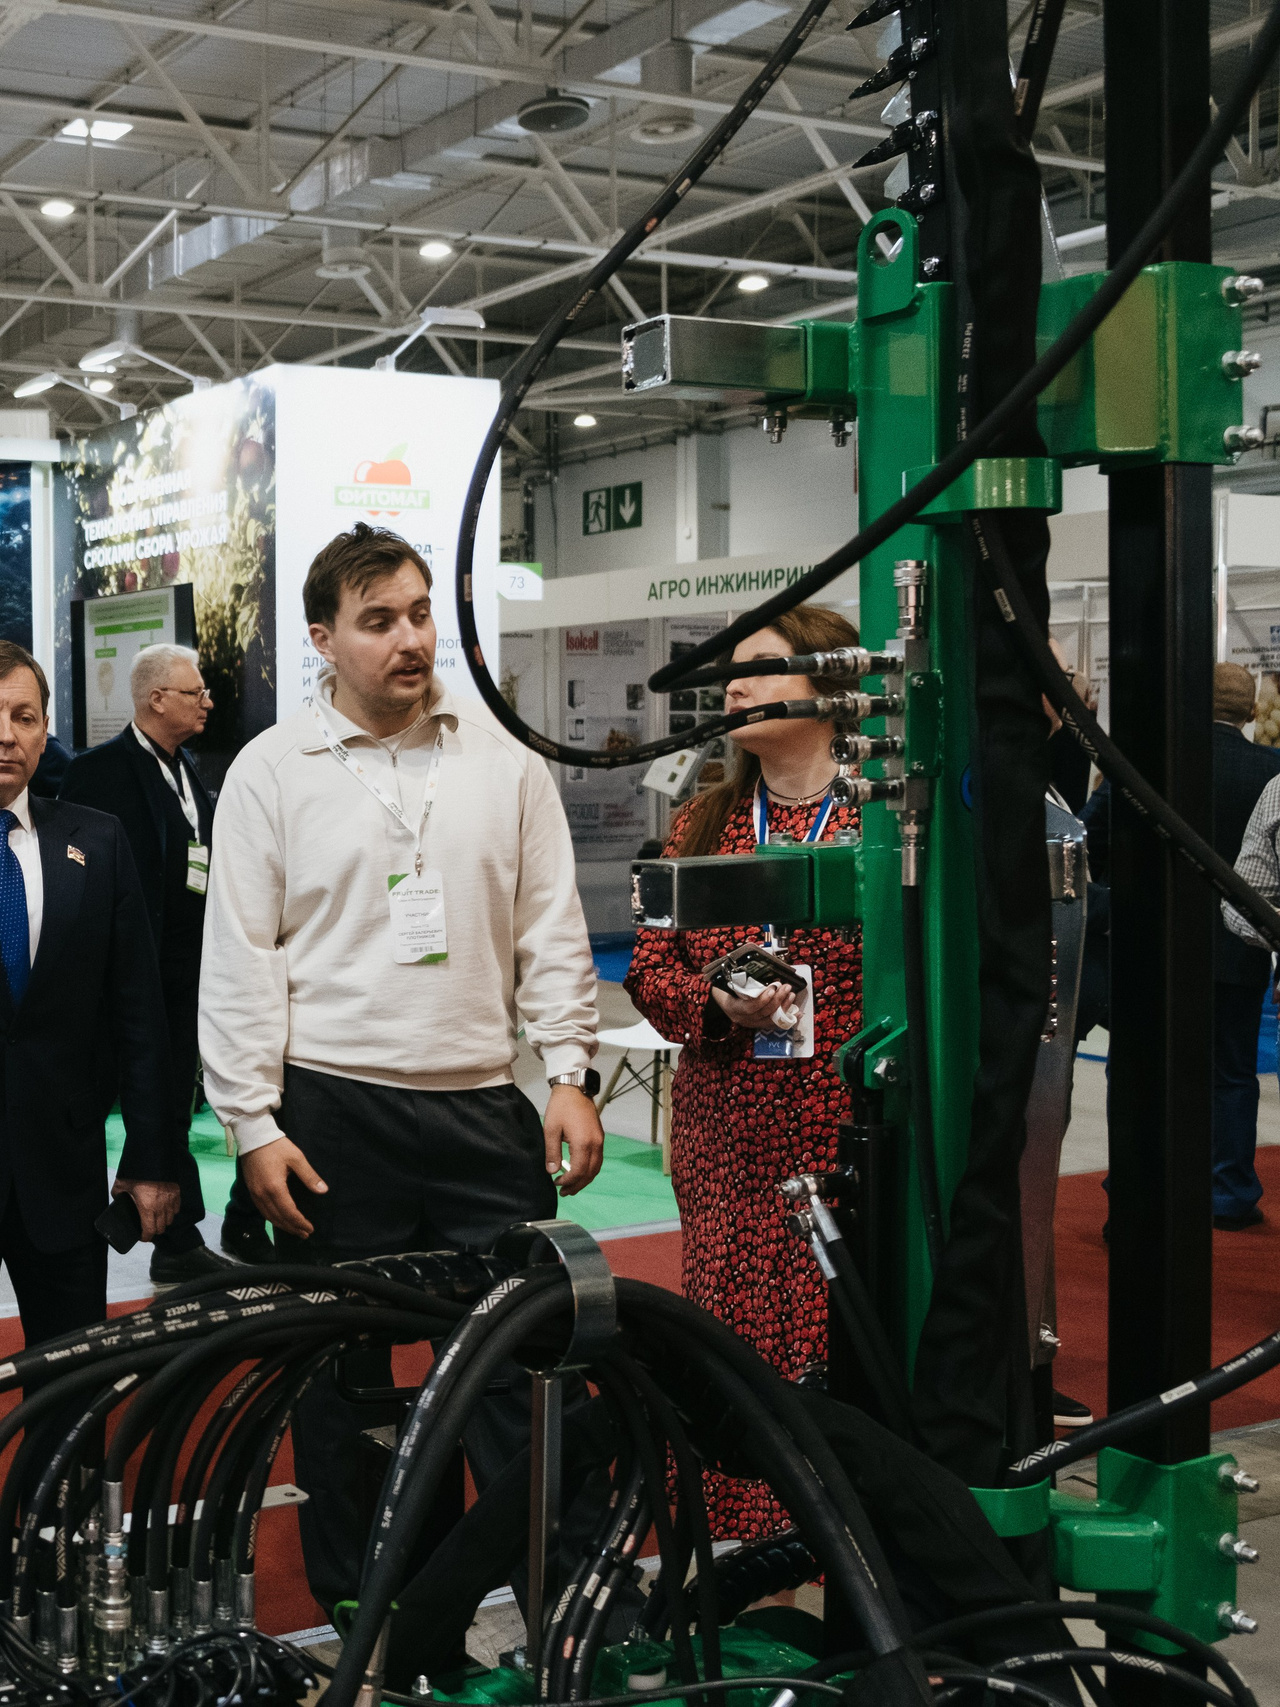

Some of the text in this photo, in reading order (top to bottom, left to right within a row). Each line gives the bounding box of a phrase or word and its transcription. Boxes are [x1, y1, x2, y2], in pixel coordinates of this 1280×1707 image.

[962, 337, 971, 359] 2320
[338, 489, 427, 507] ФИТОМАГ
[83, 491, 228, 543] ТЕХНОЛОГИЯ УПРАВЛЕНИЯ
[84, 522, 227, 569] СРОКАМИ СБОРА УРОЖАЯ
[510, 576, 525, 589] 73
[647, 564, 817, 601] АГРО ИНЖИНИРИН
[566, 630, 599, 650] Isolcell
[165, 1301, 201, 1318] 2320 Psi
[240, 1306, 261, 1317] 2320
